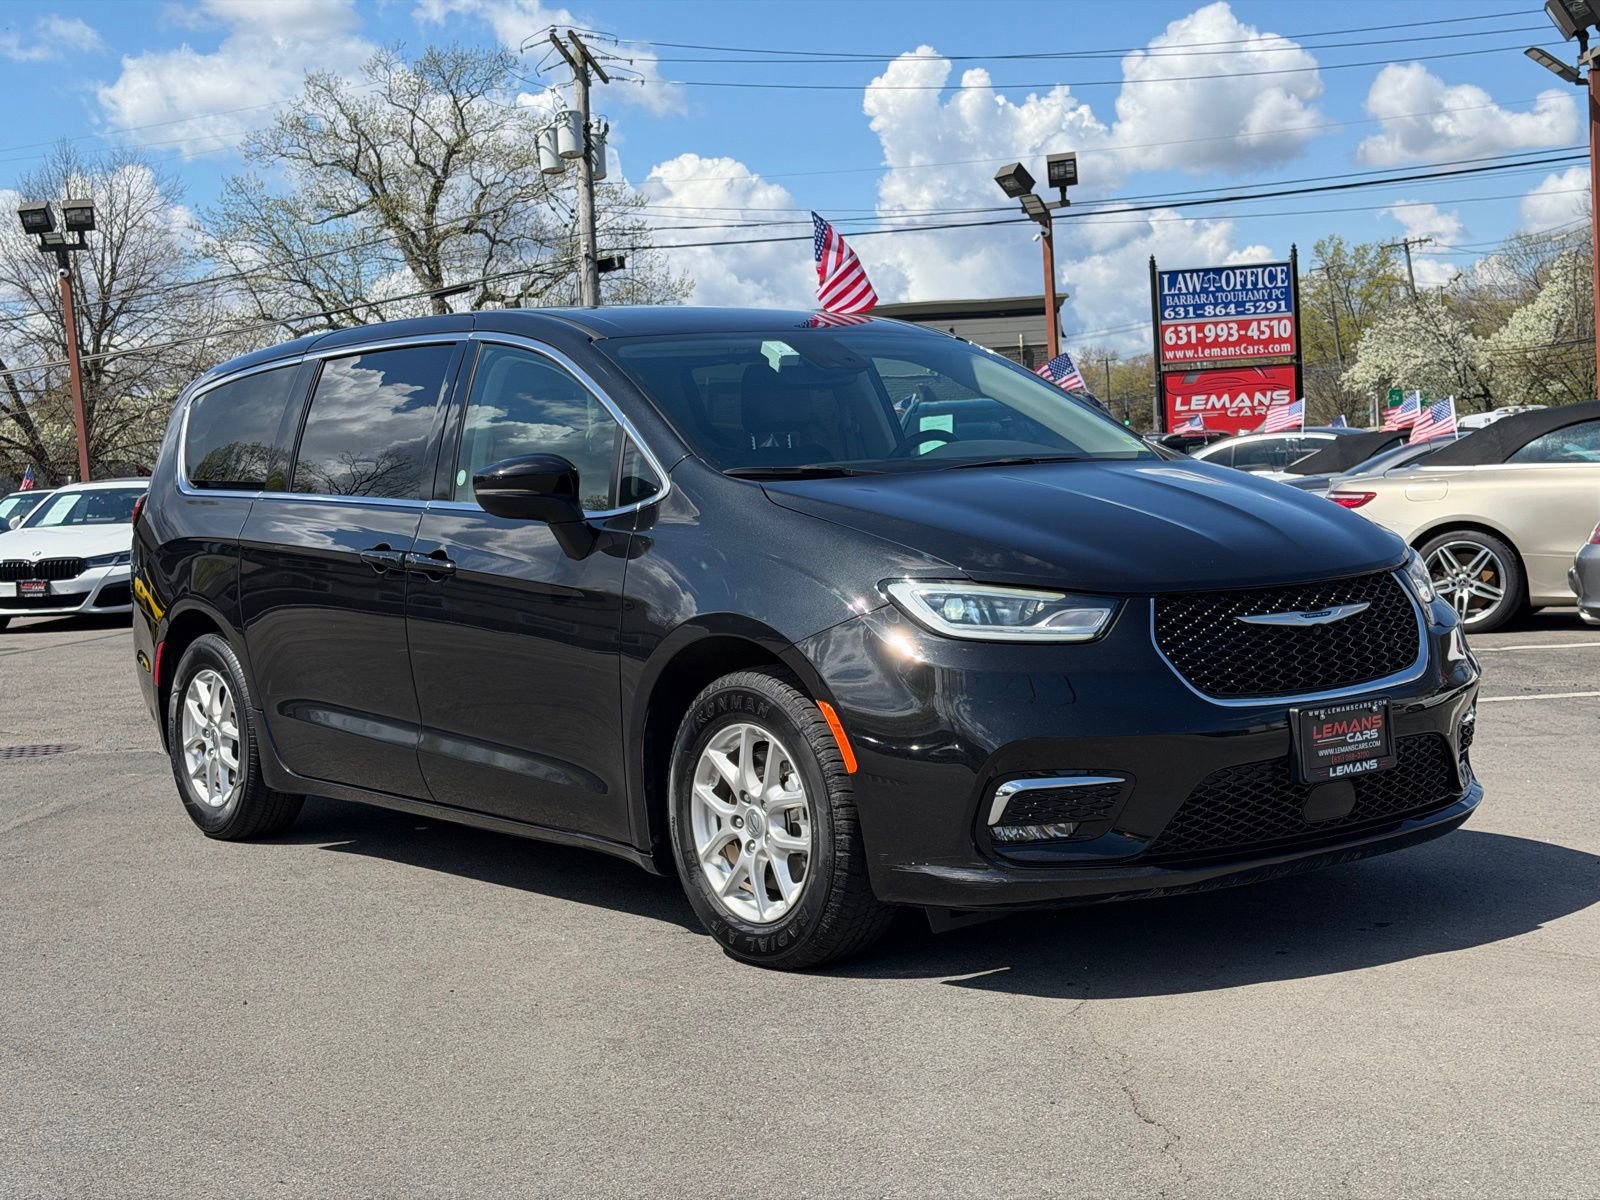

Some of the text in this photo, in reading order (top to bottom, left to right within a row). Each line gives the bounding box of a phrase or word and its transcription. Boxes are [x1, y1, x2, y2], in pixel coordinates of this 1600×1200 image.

[1162, 266, 1288, 295] LAW OFFICE
[1166, 289, 1285, 306] BARBARA TOUHAMY PC
[1164, 301, 1287, 319] 631-864-5291
[1164, 319, 1292, 345] 631-993-4510
[1165, 342, 1291, 359] www.LemansCars.com
[1174, 390, 1291, 411] LEMANS
[1227, 406, 1274, 417] CAR
[1308, 700, 1387, 716] WWW.LEMANSCARS.COM
[1312, 714, 1382, 739] LEMANS
[1346, 729, 1378, 742] CARS
[1318, 740, 1381, 756] WWW.LEMANSCARS.COM
[1330, 759, 1378, 777] LEMANS
